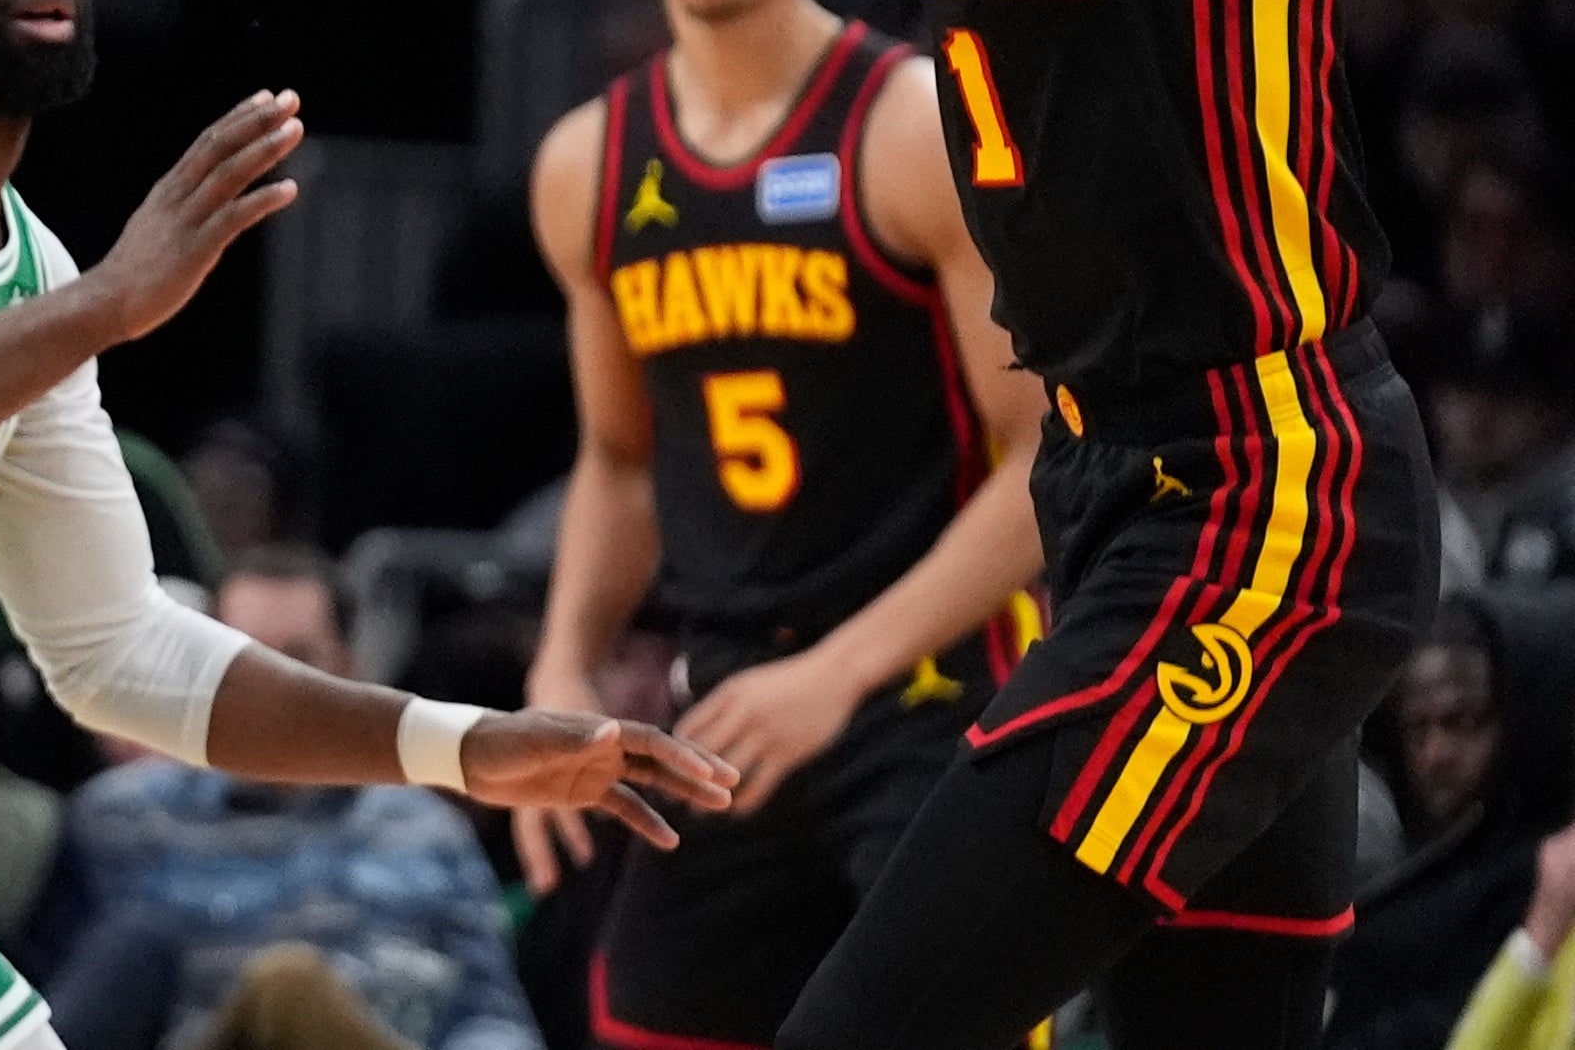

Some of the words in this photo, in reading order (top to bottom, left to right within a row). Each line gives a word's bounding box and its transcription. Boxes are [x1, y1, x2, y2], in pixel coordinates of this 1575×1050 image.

[941, 26, 1026, 188] 1
[608, 241, 858, 351] HAWKS
[700, 368, 803, 514] 5
